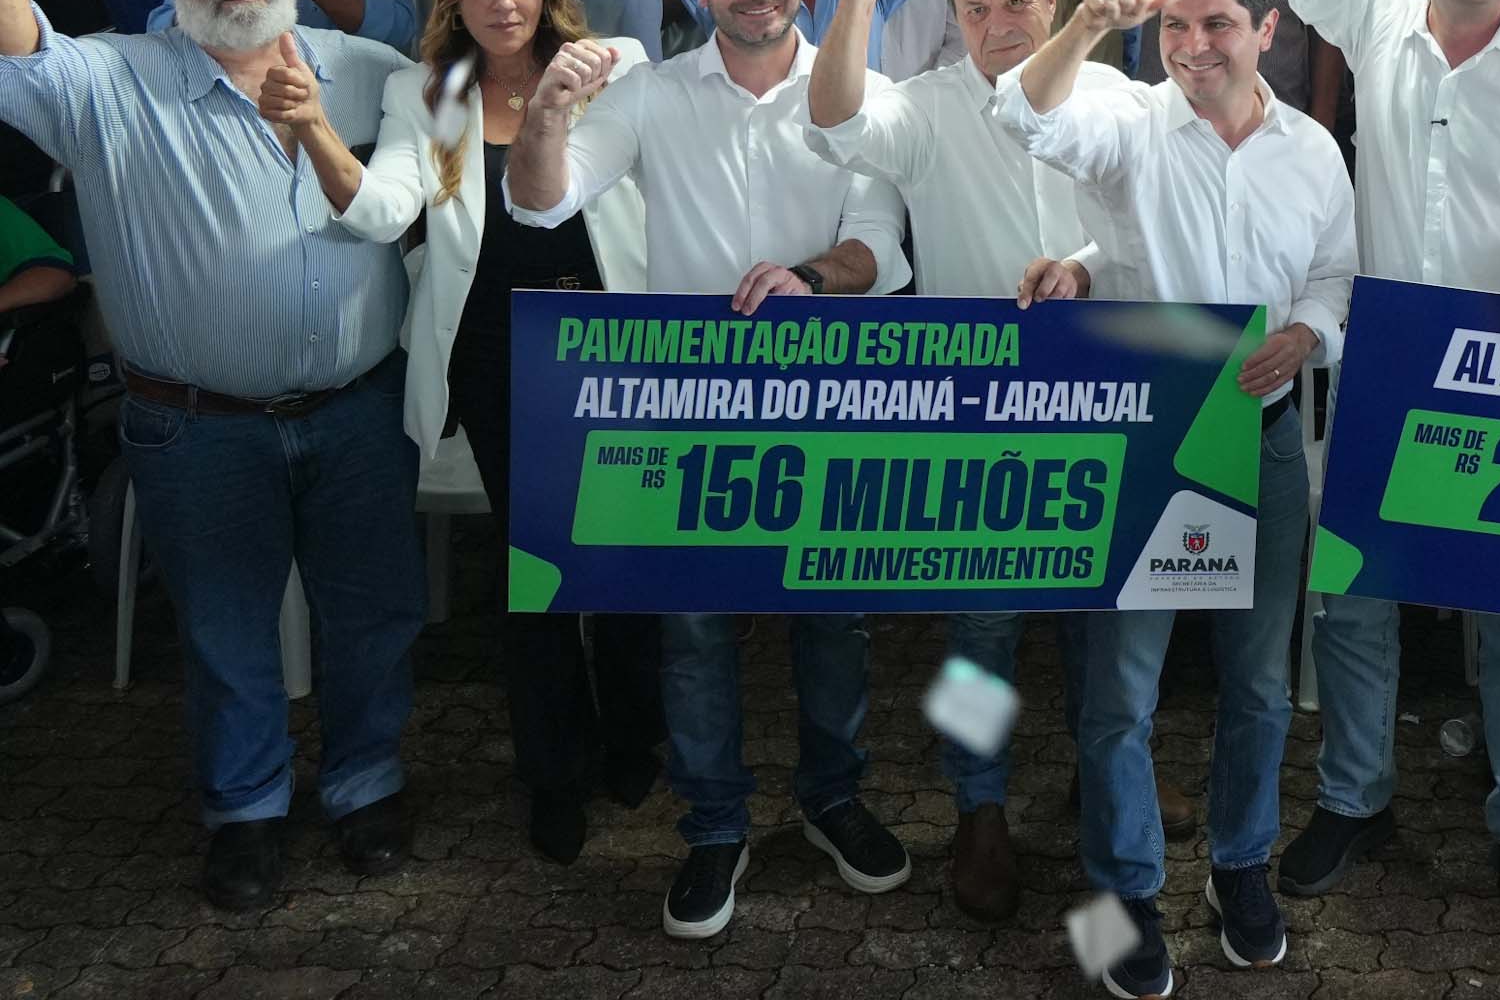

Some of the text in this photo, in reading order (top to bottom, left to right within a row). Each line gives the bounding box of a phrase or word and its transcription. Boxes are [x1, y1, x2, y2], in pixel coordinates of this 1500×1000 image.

[557, 317, 1019, 370] PAVIMENTAÇÃO ESTRADA
[574, 377, 752, 419] ALTAMIRA
[761, 379, 810, 420] DO
[816, 376, 954, 420] PARANÁ
[985, 381, 1153, 422] LARANJAL
[1414, 424, 1487, 450] MAIS DE
[598, 447, 669, 465] MAIS DE
[1455, 453, 1480, 474] R$
[642, 469, 665, 489] R$
[677, 445, 1107, 531] 156 MILHÕES
[799, 547, 1093, 580] EM INVESTIMENTOS
[1150, 555, 1239, 572] PARANÁ
